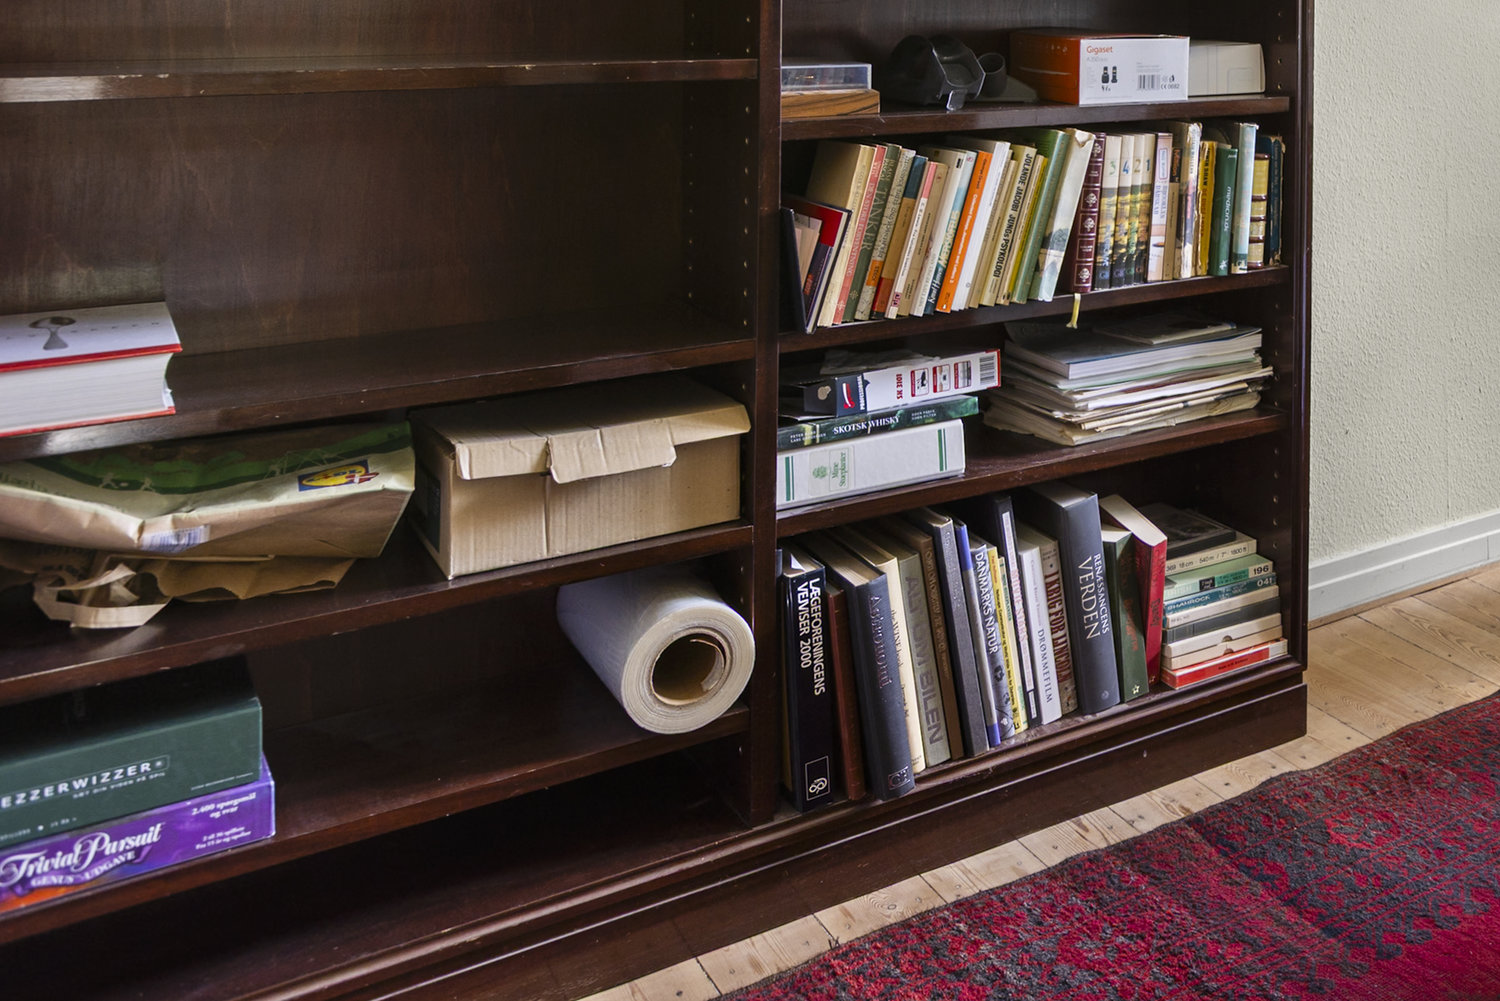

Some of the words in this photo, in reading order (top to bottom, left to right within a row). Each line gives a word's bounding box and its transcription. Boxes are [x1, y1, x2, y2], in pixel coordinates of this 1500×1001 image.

[1087, 46, 1113, 55] Gigaset
[1017, 152, 1033, 186] JOLANDE
[1123, 160, 1129, 174] 4
[1134, 159, 1141, 173] 2
[1147, 159, 1150, 171] 1
[1010, 185, 1024, 212] JACOBI
[861, 186, 887, 251] TANKER
[1002, 213, 1015, 238] JUNGs
[992, 237, 1009, 278] PSYKOLOGI
[896, 390, 903, 400] SK
[833, 419, 868, 435] SKOTSK
[868, 415, 900, 429] WHISKY
[974, 552, 993, 616] DANMARKS
[1008, 568, 1024, 605] MOVIE
[1254, 565, 1269, 575] 196
[1257, 577, 1272, 587] 041
[796, 581, 810, 636] VEJVISER
[905, 576, 921, 618] ALT
[1046, 581, 1063, 607] KRIG
[1078, 556, 1100, 640] VERDEN
[1094, 553, 1110, 634] RENÆSSANCENS
[1167, 595, 1210, 611] SHAMROCK
[1014, 607, 1028, 642] STARS
[1049, 607, 1066, 634] FOR
[1148, 598, 1160, 626] Dandy
[808, 578, 826, 696] LÆGEFORENINGENS
[869, 595, 893, 689] Astronomi
[912, 621, 929, 666] OM
[983, 614, 998, 654] NATUR
[800, 638, 812, 669] 2000
[1037, 629, 1052, 703] DRØMMEFILM
[1052, 635, 1072, 683] LINCOLN
[920, 672, 944, 745] BILEN
[0, 844, 80, 887] Trivial
[71, 823, 162, 872] Pursuit
[30, 874, 74, 887] GENUS
[85, 851, 136, 880] UDGAVE
